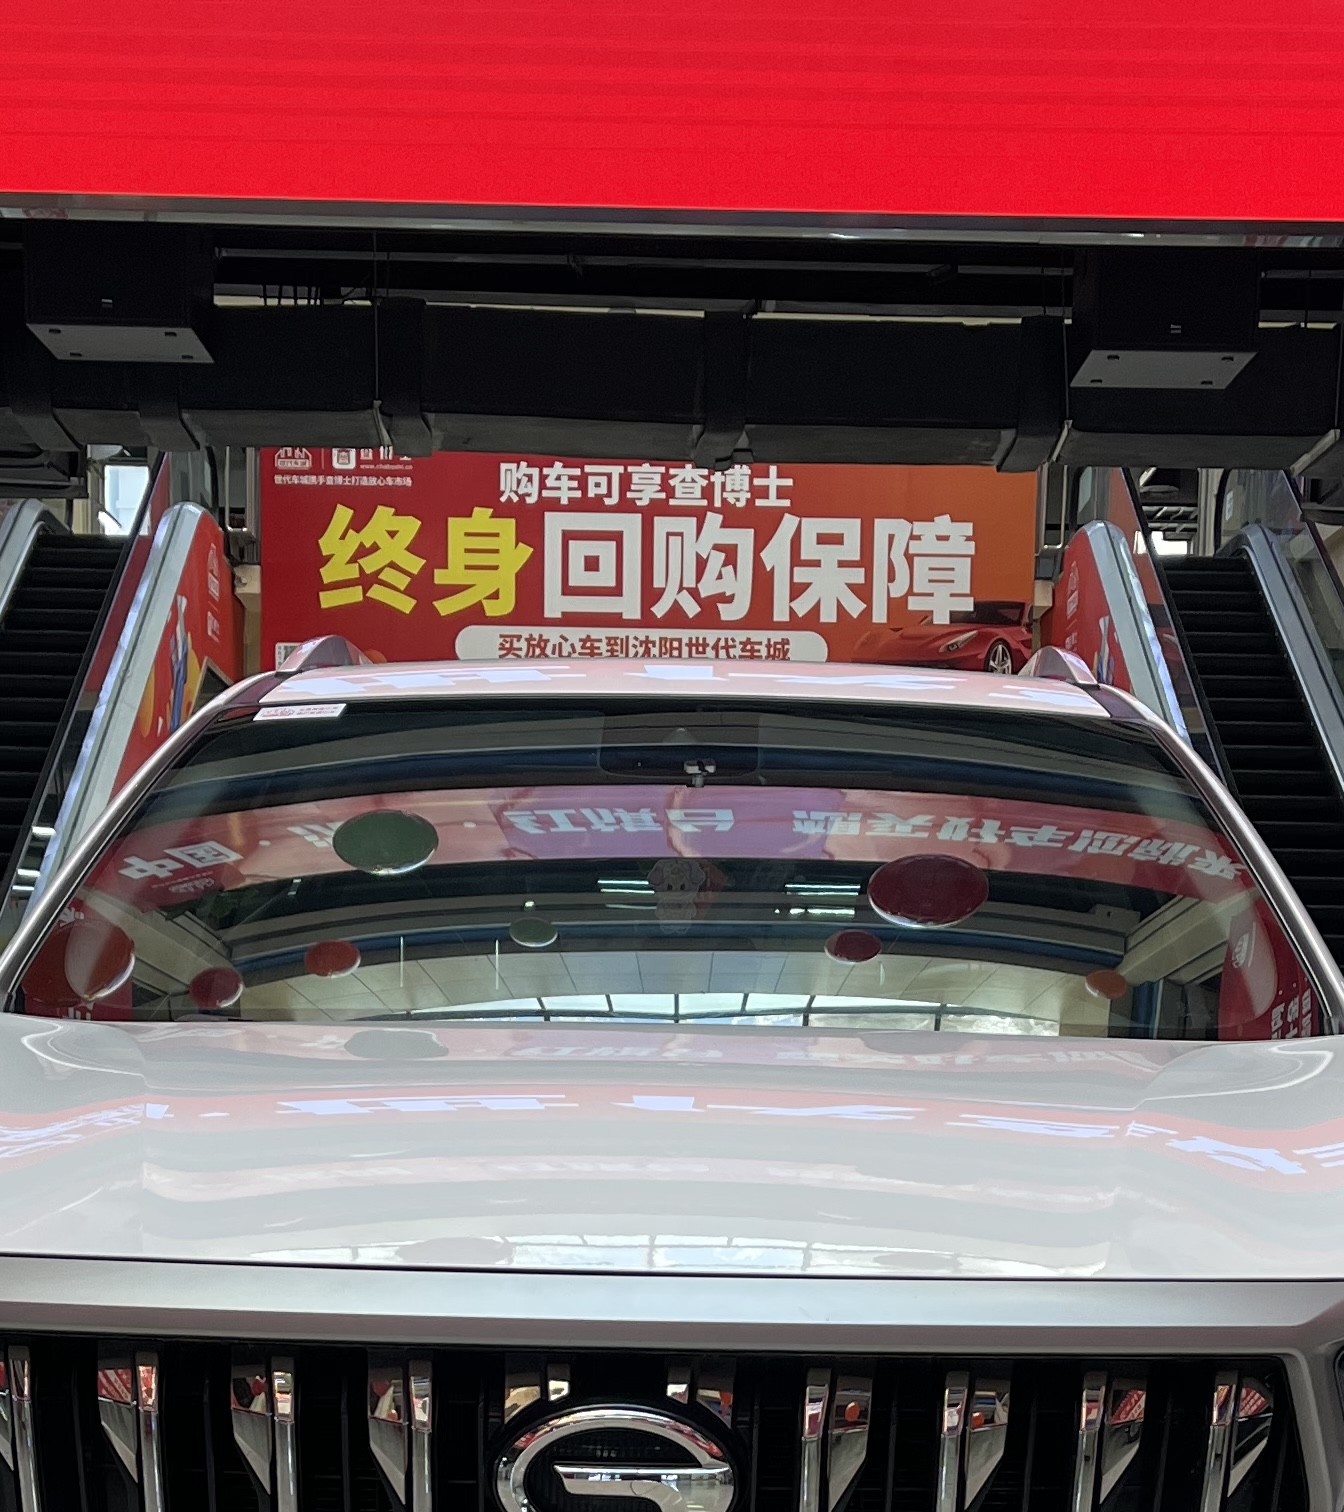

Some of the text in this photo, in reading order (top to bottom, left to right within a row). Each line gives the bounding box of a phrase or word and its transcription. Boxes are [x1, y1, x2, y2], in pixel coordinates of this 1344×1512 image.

[499, 461, 794, 508] 购车可享查博士
[317, 504, 976, 624] 终身回购保障
[498, 633, 791, 661] 买放心车到沈阳世代车城
